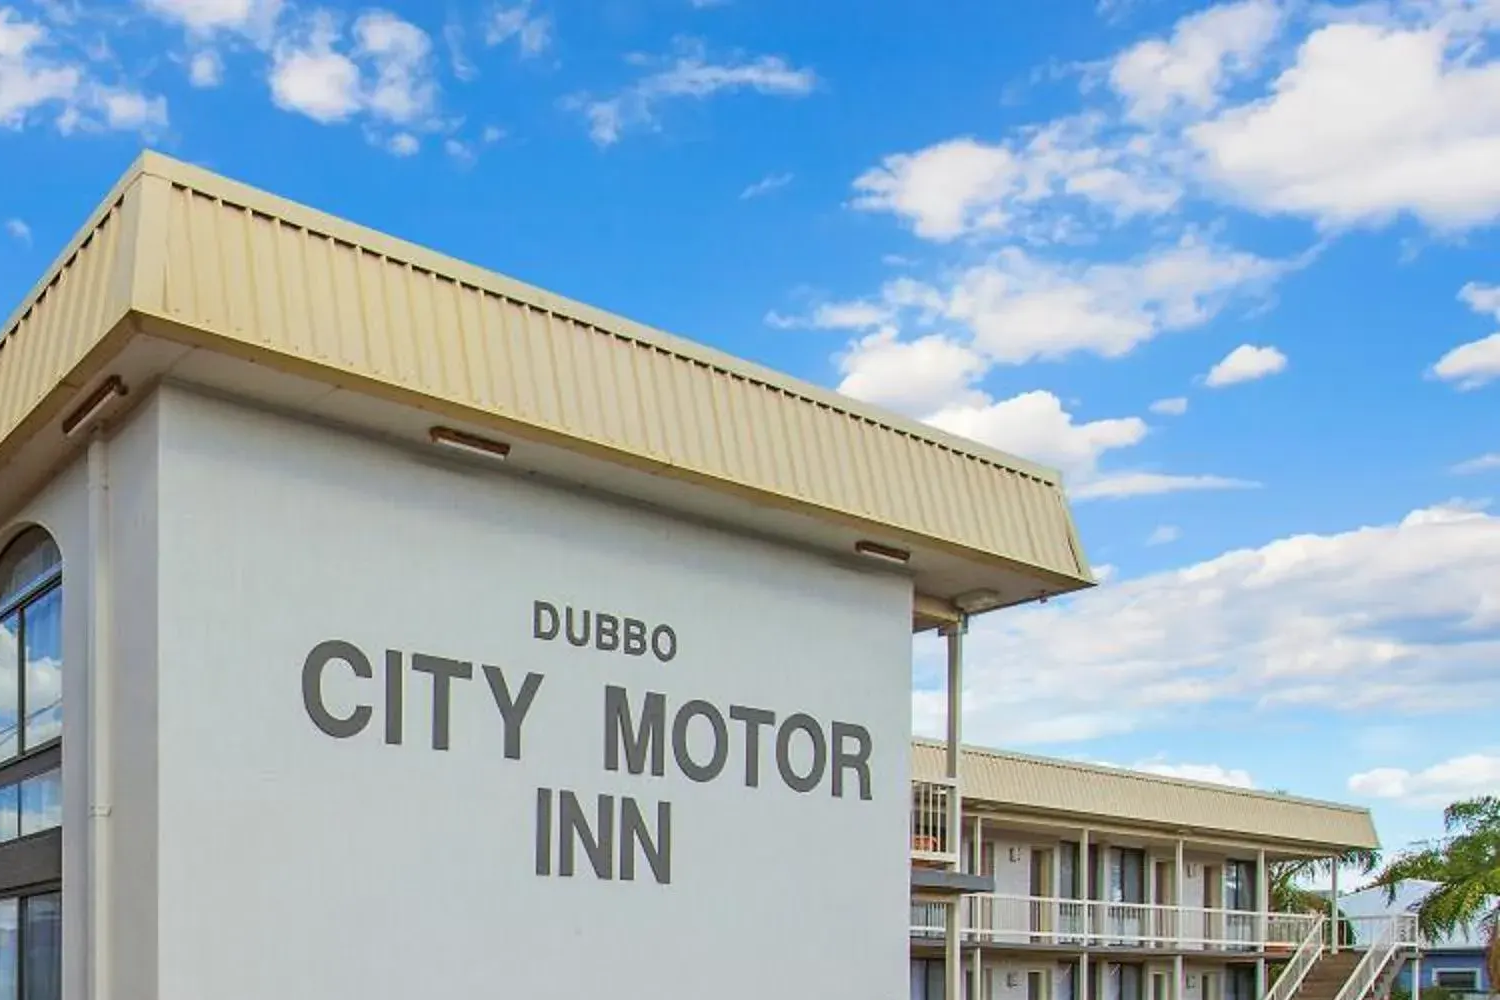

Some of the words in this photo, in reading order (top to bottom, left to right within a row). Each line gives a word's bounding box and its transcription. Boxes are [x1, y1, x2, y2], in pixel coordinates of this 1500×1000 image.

[533, 600, 677, 662] DUBBO
[301, 640, 544, 760] CITY
[604, 684, 873, 800] MOTOR
[536, 787, 671, 884] INN
